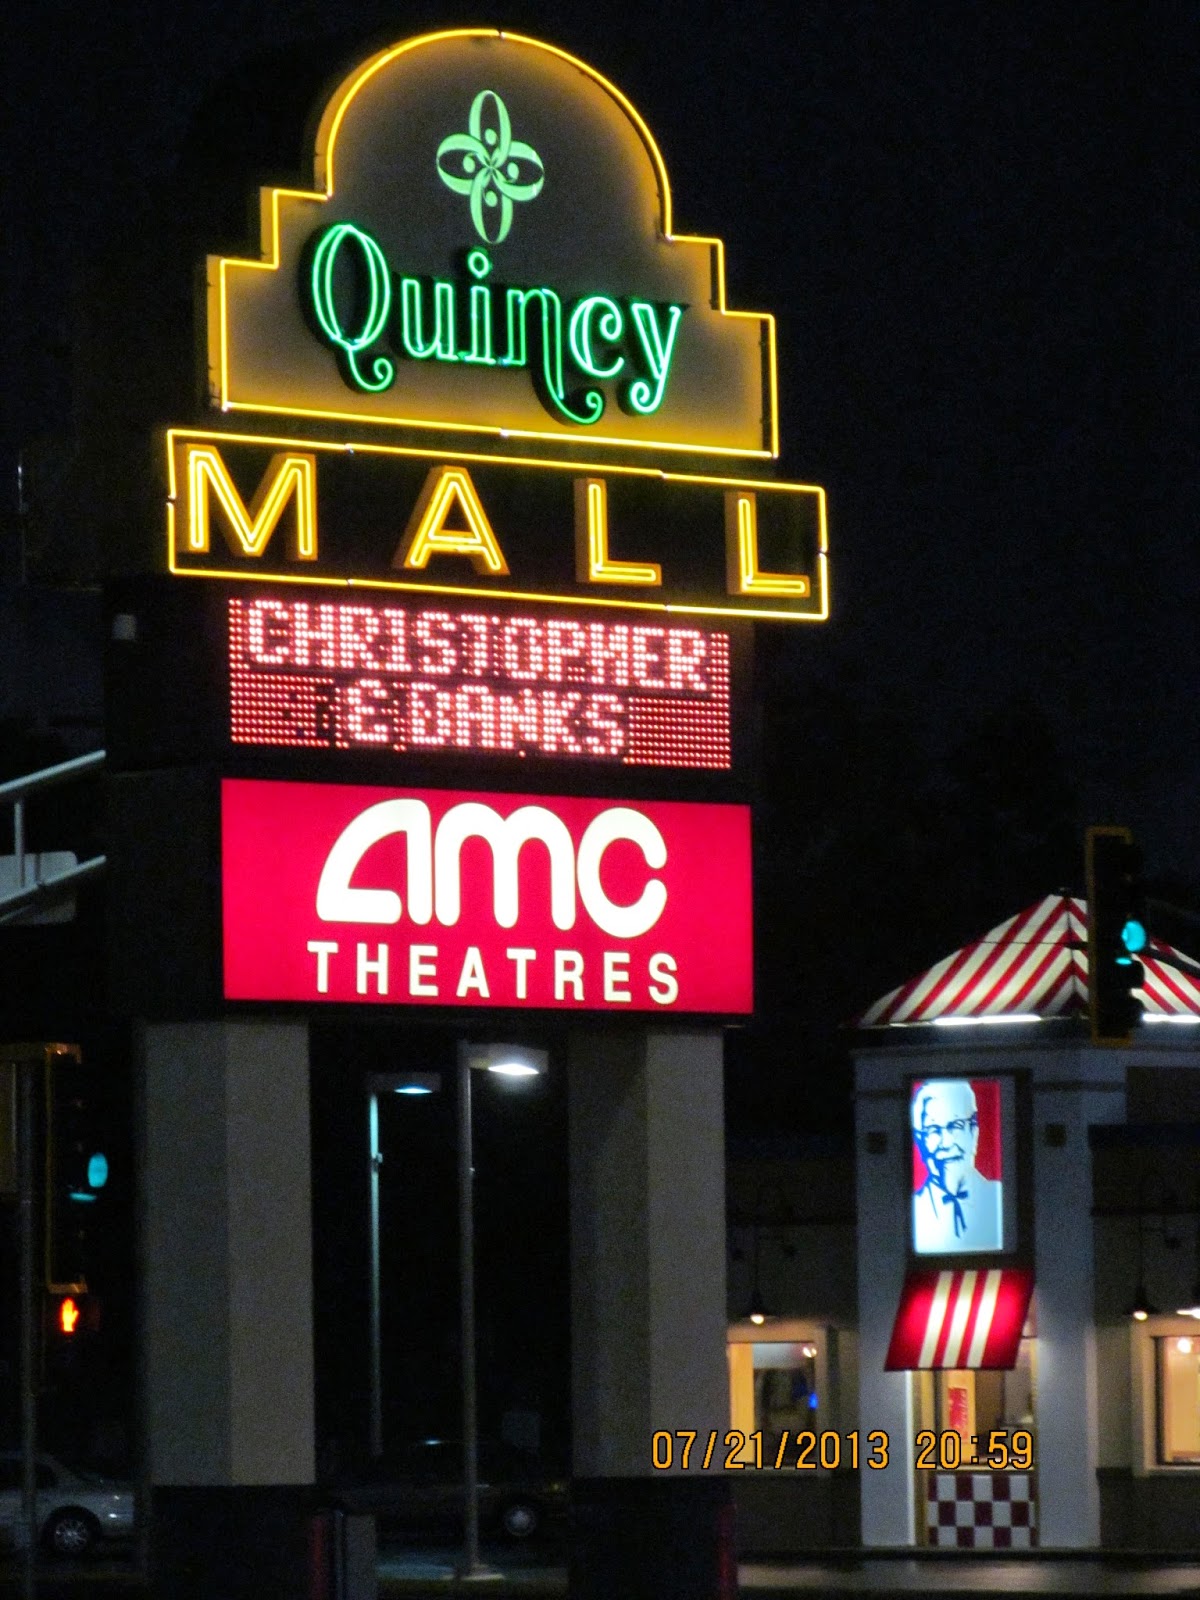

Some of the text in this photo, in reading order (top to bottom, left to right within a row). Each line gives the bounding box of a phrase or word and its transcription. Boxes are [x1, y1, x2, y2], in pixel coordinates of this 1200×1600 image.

[312, 223, 682, 425] Quincy
[186, 443, 811, 598] MALL
[247, 599, 708, 692] CHRISTOPHER
[307, 941, 680, 1005] THEATRES
